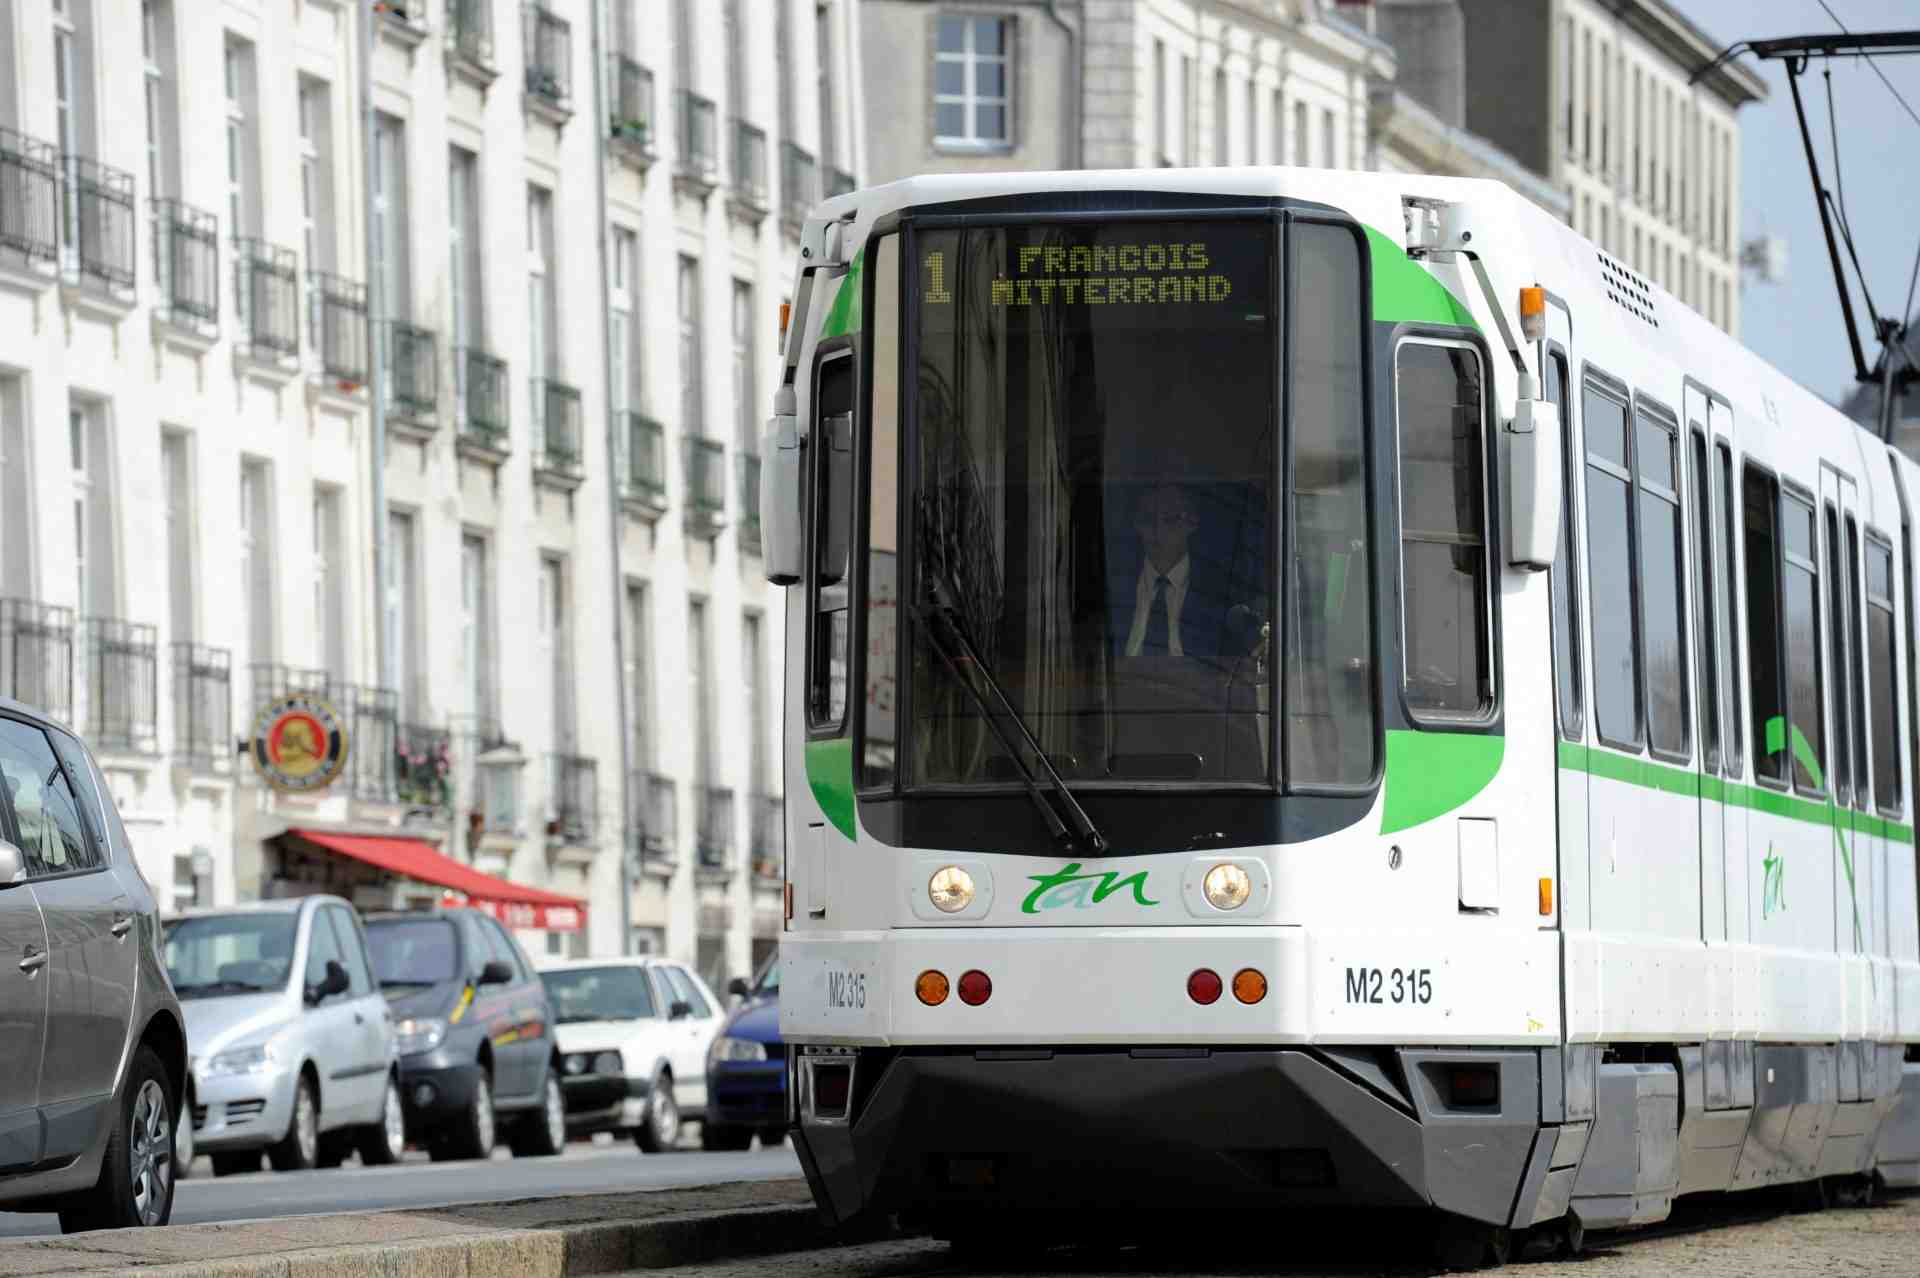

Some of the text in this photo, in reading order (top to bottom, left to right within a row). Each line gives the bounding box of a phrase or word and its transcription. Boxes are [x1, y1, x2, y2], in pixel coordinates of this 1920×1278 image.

[1019, 243, 1210, 273] FRANCOIS
[925, 252, 951, 304] 1
[992, 275, 1233, 305] MITTERRAND
[1021, 862, 1161, 914] tan
[829, 971, 866, 1009] M2 315
[1346, 967, 1433, 1004] M2 315
